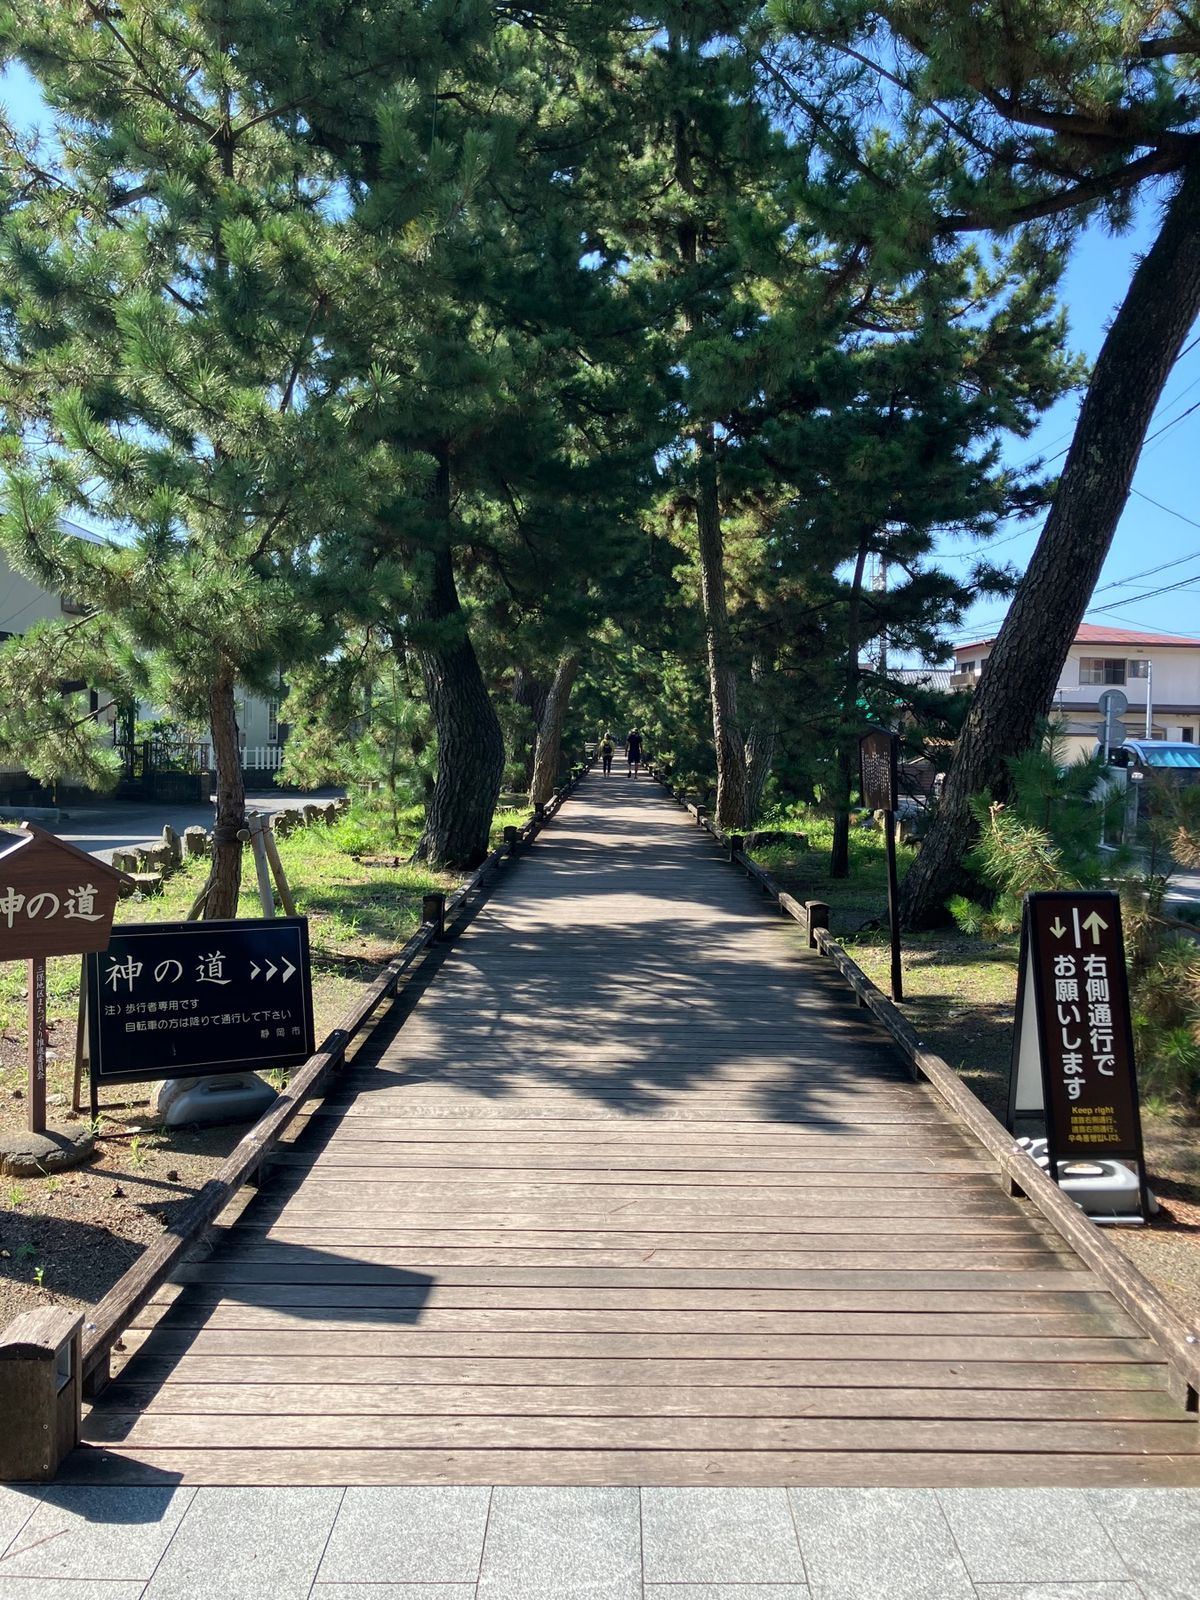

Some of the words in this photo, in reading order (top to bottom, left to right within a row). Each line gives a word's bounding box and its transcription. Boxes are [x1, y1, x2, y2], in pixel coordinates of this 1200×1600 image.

[0, 883, 105, 928] 神の道
[104, 950, 233, 992] 神の道
[125, 1010, 292, 1033] 自転車の方は降りて通行して下さい
[1053, 954, 1086, 1101] お願いします
[1083, 953, 1115, 1076] 右側通行で
[1071, 1106, 1093, 1116] Keep
[1094, 1106, 1115, 1116] right
